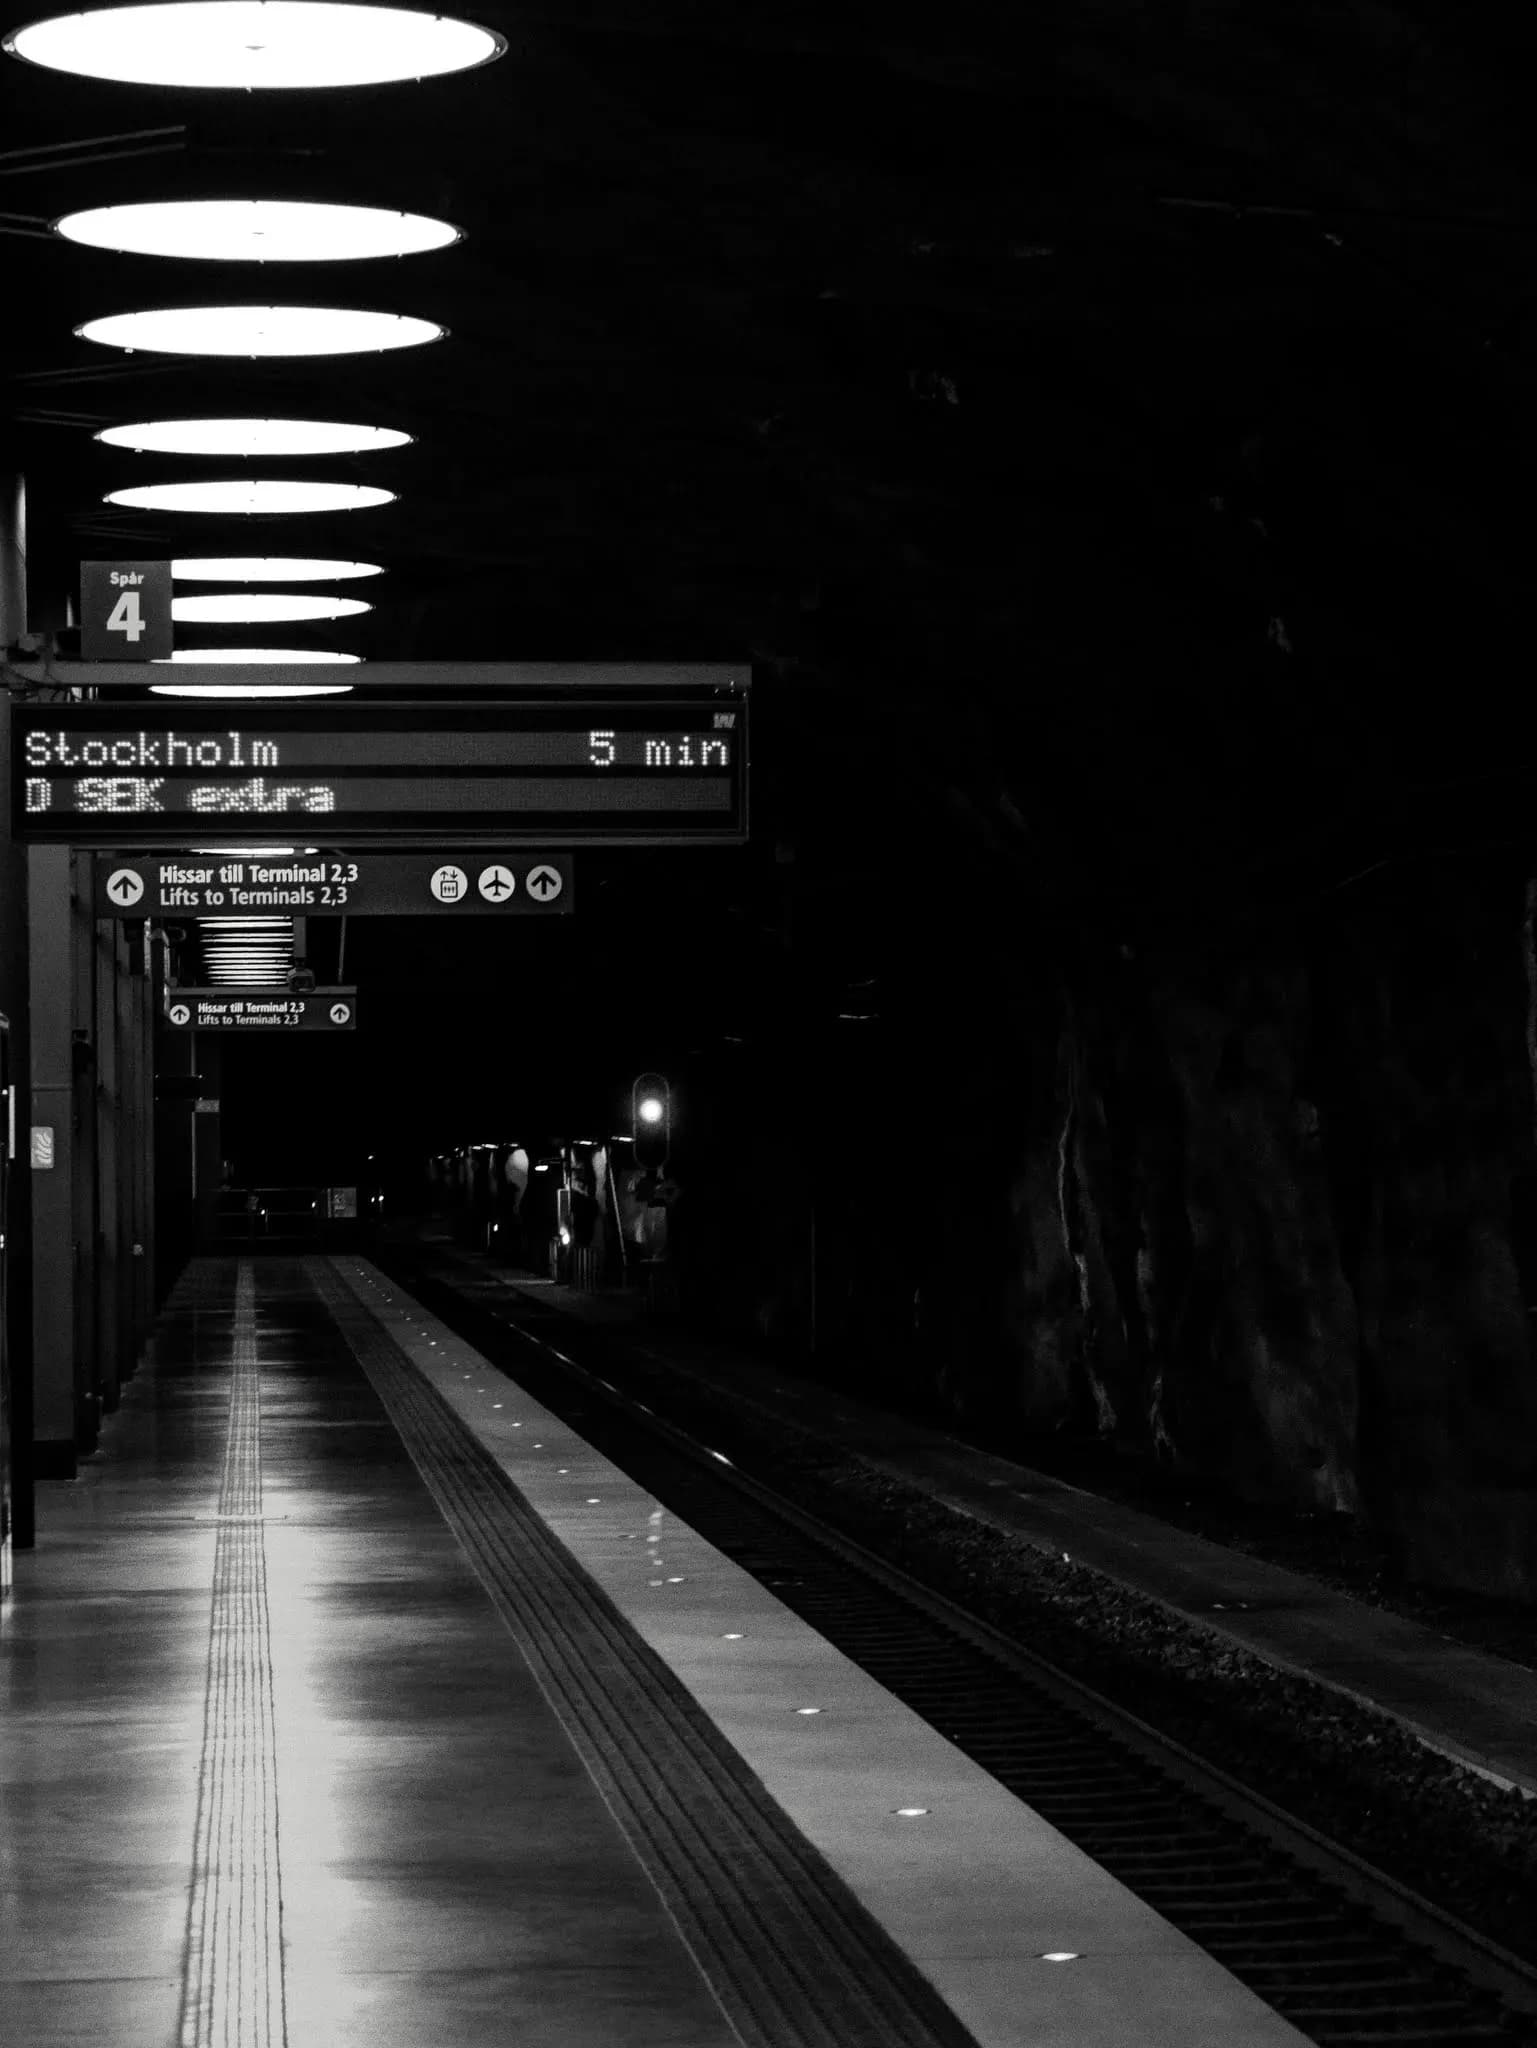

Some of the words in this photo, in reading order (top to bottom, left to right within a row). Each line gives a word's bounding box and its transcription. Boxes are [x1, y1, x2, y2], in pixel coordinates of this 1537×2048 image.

[109, 571, 145, 587] Spår
[106, 591, 146, 642] 4
[26, 731, 278, 766] Stockholm
[589, 731, 615, 766] 5
[645, 735, 728, 766] min
[187, 777, 335, 812] extra
[159, 864, 214, 884] Hissar
[218, 863, 244, 884] till
[248, 863, 326, 884] Terminal
[330, 864, 359, 885] 2,3
[160, 886, 200, 906] Lifts
[203, 888, 225, 906] to
[229, 886, 315, 906] Terminals
[319, 886, 348, 907] 2,3
[198, 1002, 228, 1013] Hissar
[229, 1002, 244, 1013] till
[246, 1002, 288, 1013] Terminal
[198, 1014, 220, 1025] Lifts
[222, 1015, 233, 1025] to
[235, 1014, 282, 1025] Terminals
